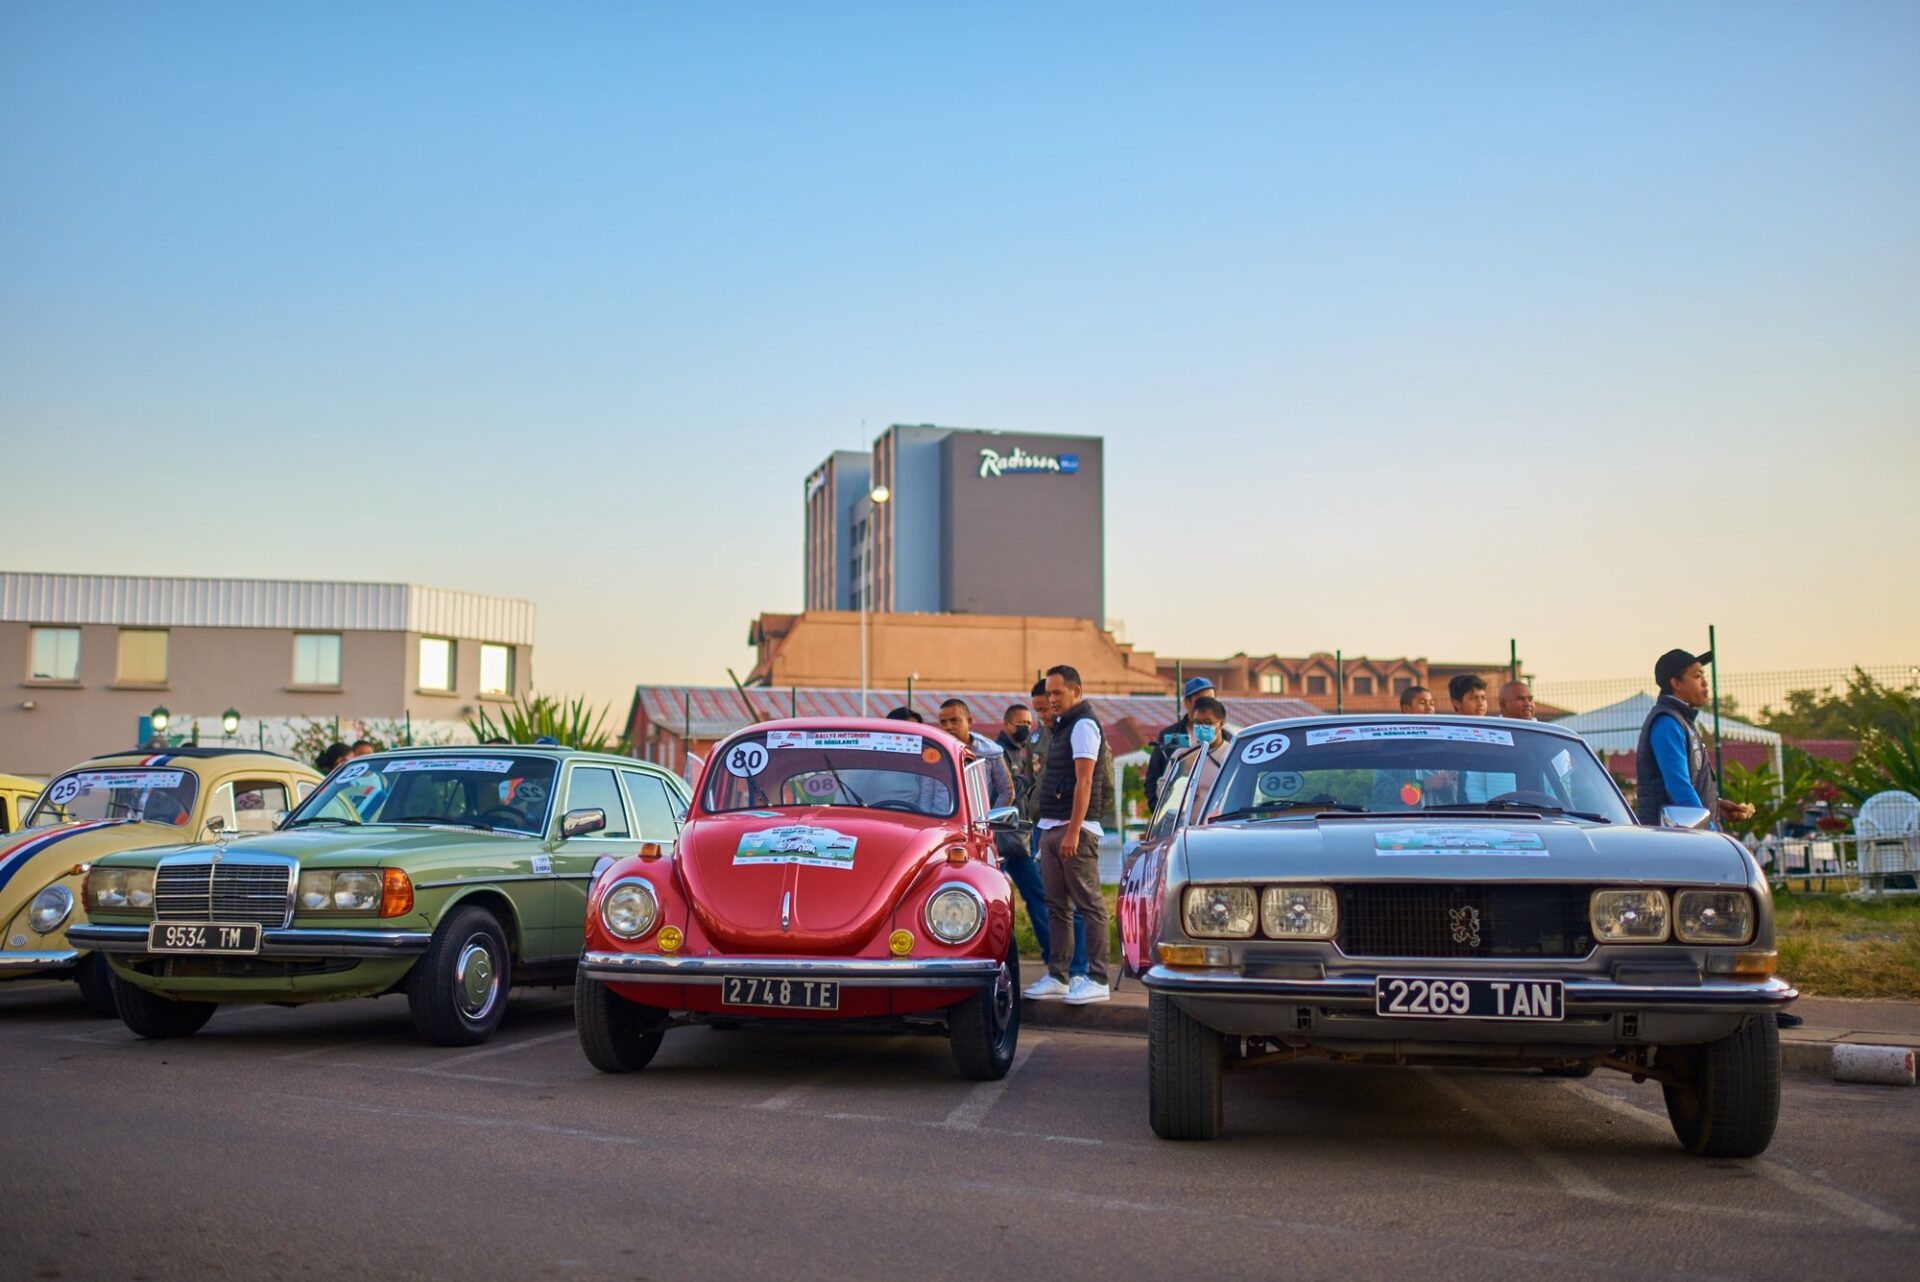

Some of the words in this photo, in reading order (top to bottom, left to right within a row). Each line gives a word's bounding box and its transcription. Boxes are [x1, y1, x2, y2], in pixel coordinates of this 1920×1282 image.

[980, 447, 1060, 477] Radisson
[732, 750, 762, 769] 80
[1248, 739, 1283, 759] 56
[338, 766, 366, 780] 22
[54, 781, 76, 801] 25
[166, 926, 206, 948] 9534
[219, 928, 241, 948] TM
[729, 979, 791, 1005] 2748
[804, 982, 832, 1007] TE
[1388, 980, 1470, 1014] 2269
[1491, 984, 1552, 1016] TAN
